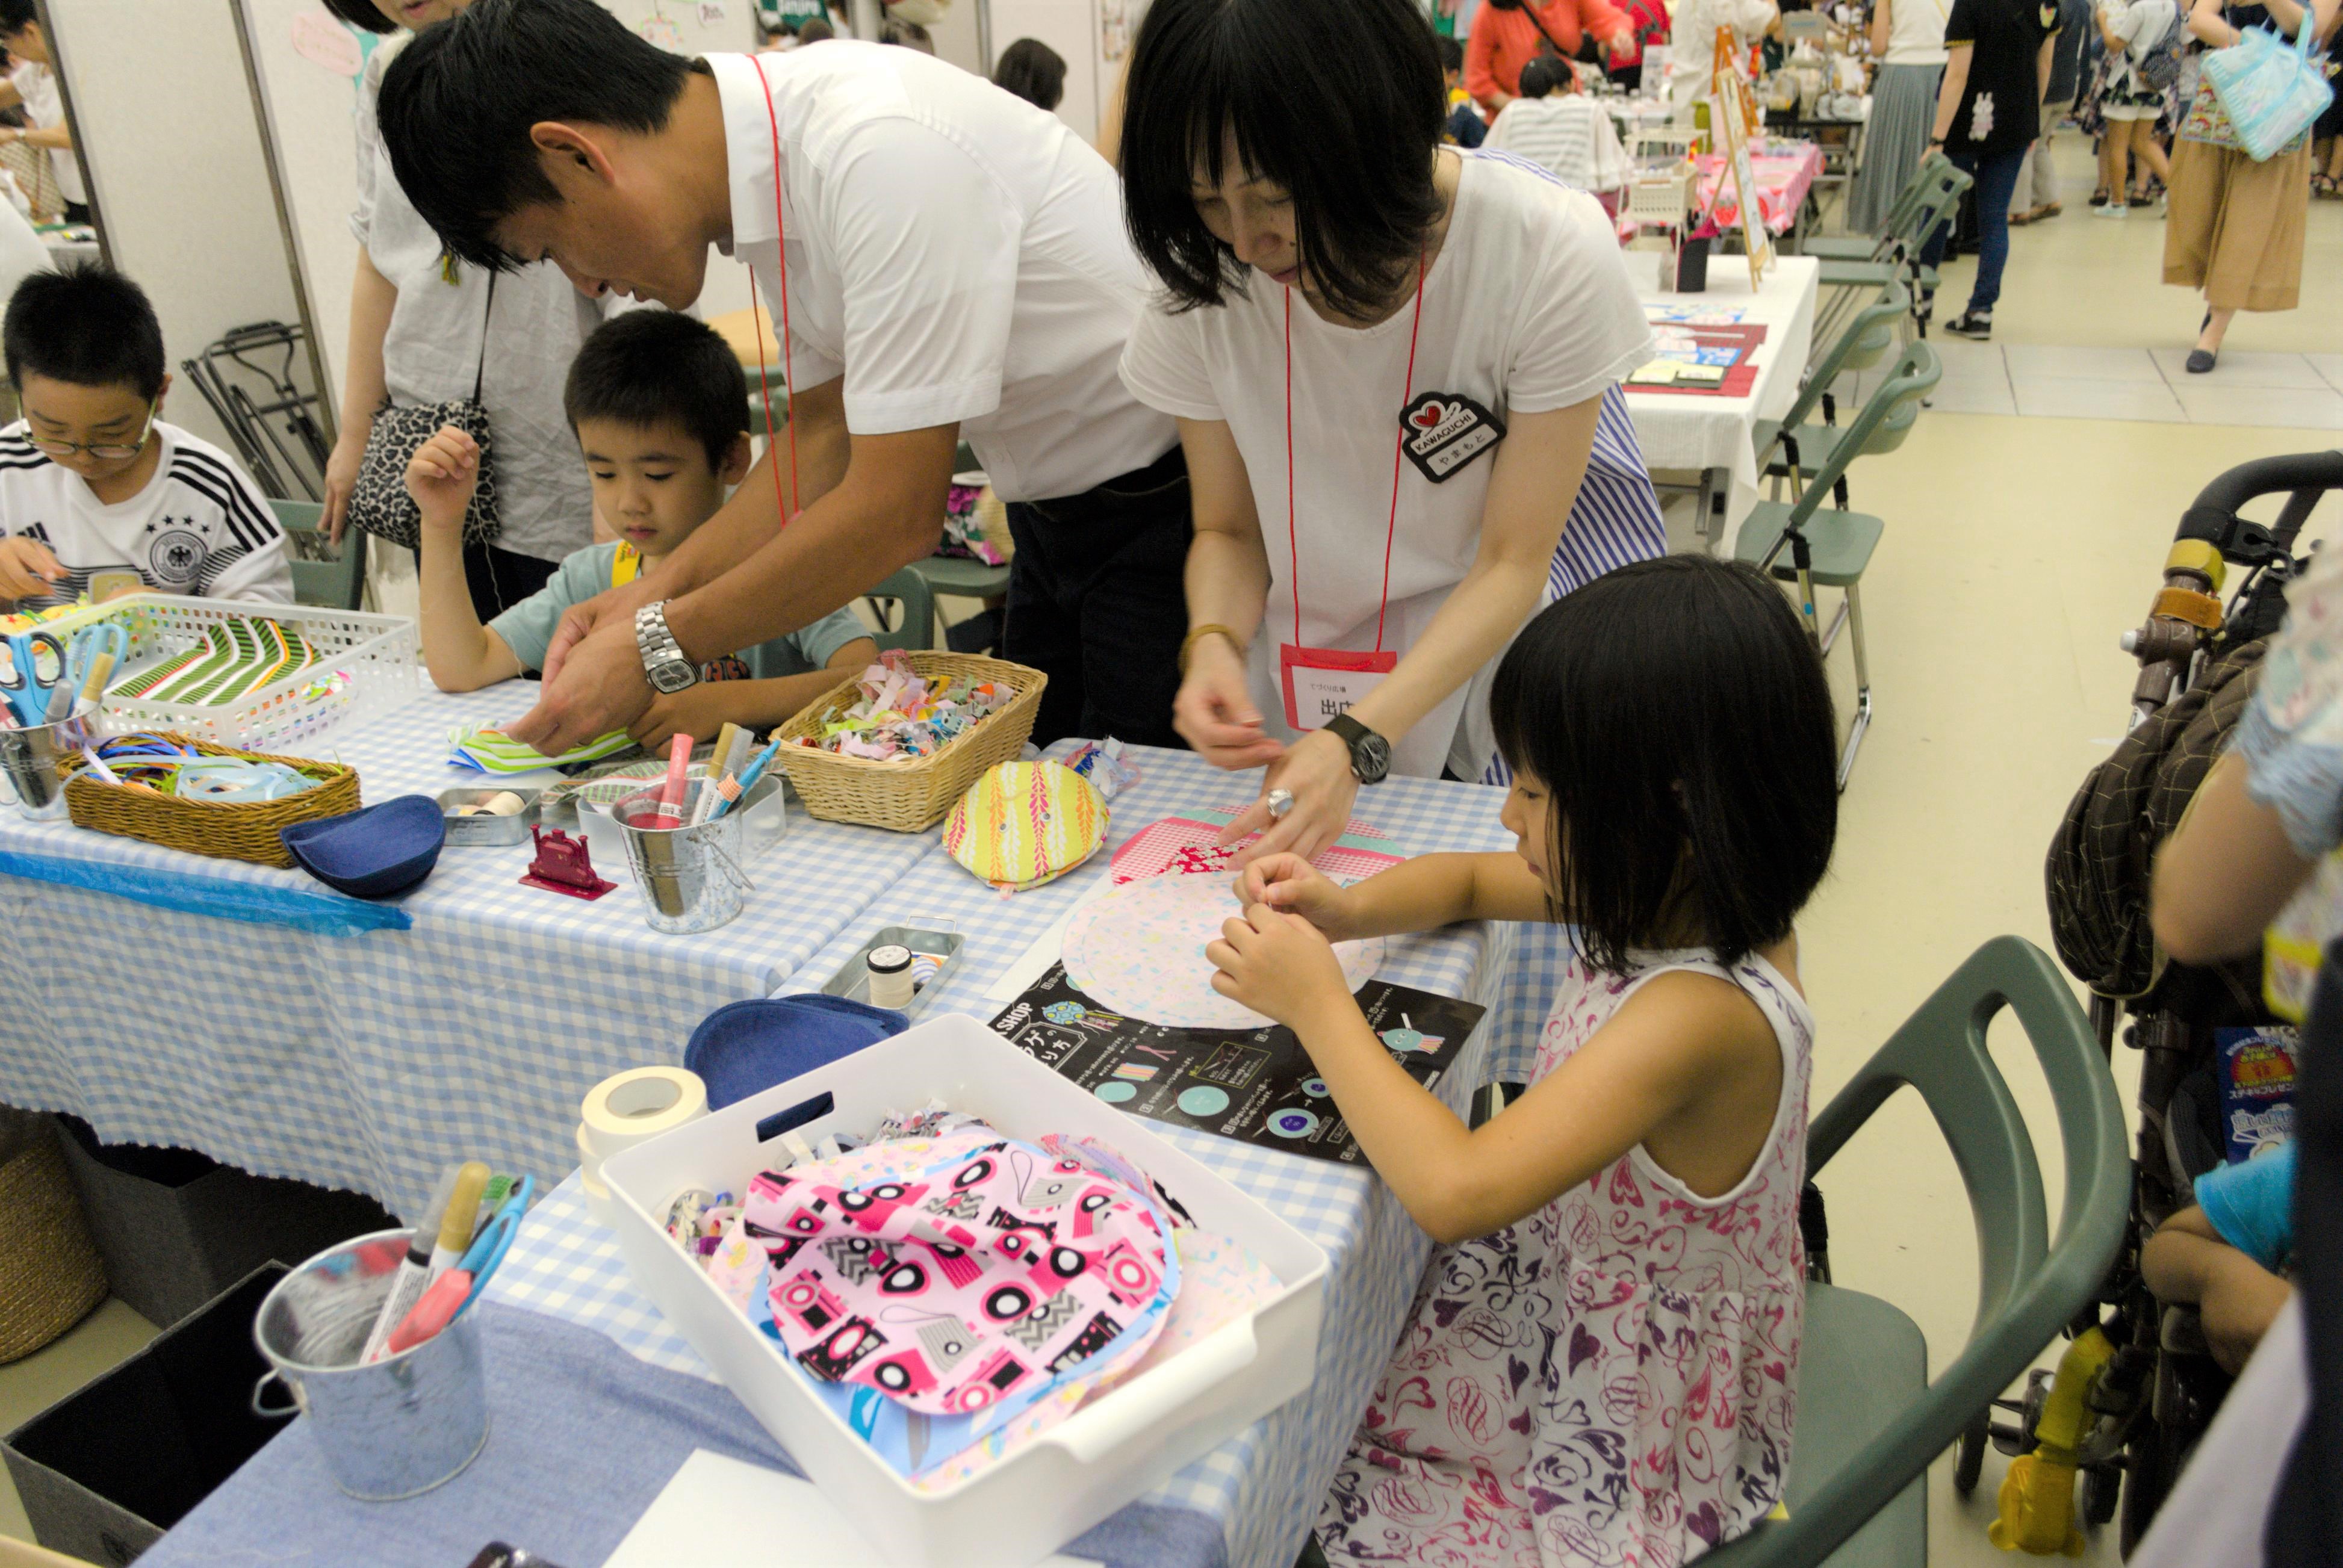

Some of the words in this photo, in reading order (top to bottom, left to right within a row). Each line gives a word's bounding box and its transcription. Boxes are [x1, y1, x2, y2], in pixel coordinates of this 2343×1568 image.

[1415, 414, 1473, 452] KAWAGUCHI
[1439, 434, 1486, 466] やまもと
[996, 1002, 1034, 1031] SHOP
[1040, 1040, 1072, 1064] り方
